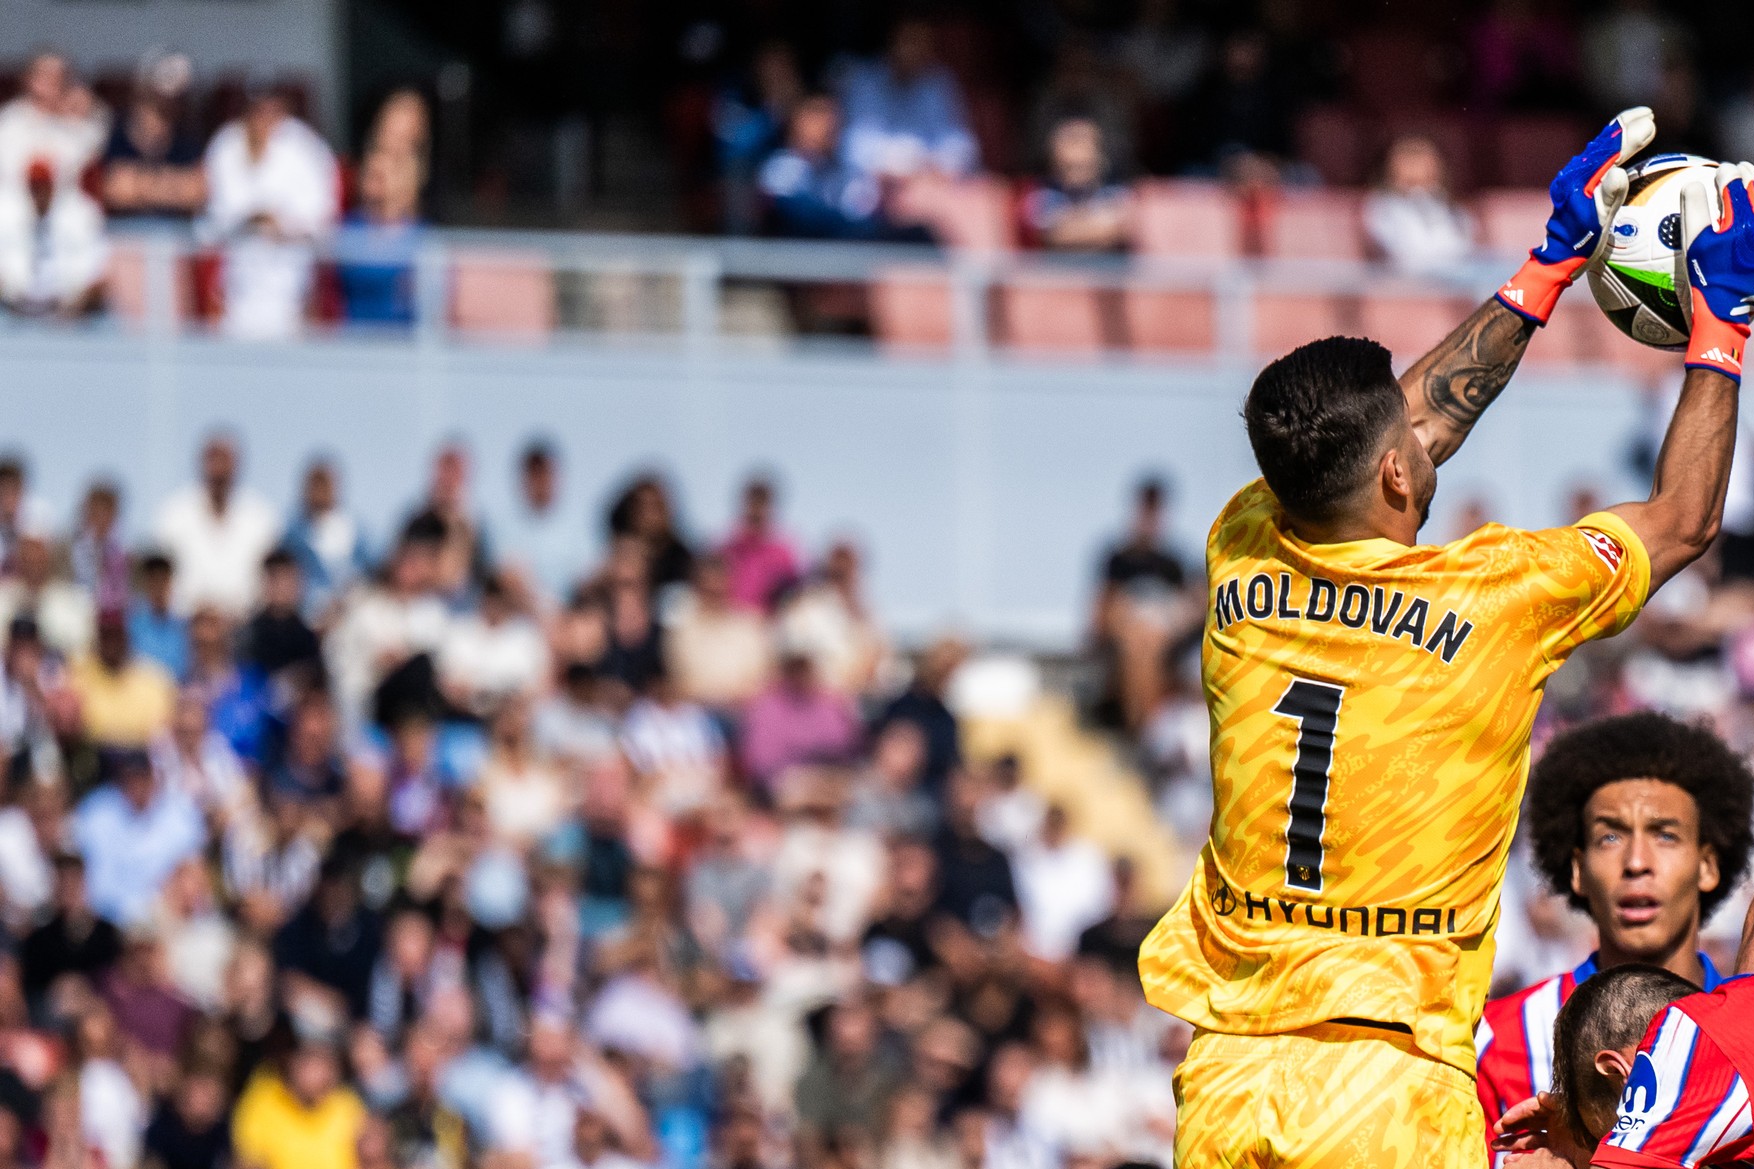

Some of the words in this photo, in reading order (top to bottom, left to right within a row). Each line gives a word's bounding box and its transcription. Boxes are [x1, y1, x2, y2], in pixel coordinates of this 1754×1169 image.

[1215, 572, 1474, 664] MOLDOVAN
[1272, 676, 1345, 894] 1
[1245, 890, 1456, 937] HYUNDAI
